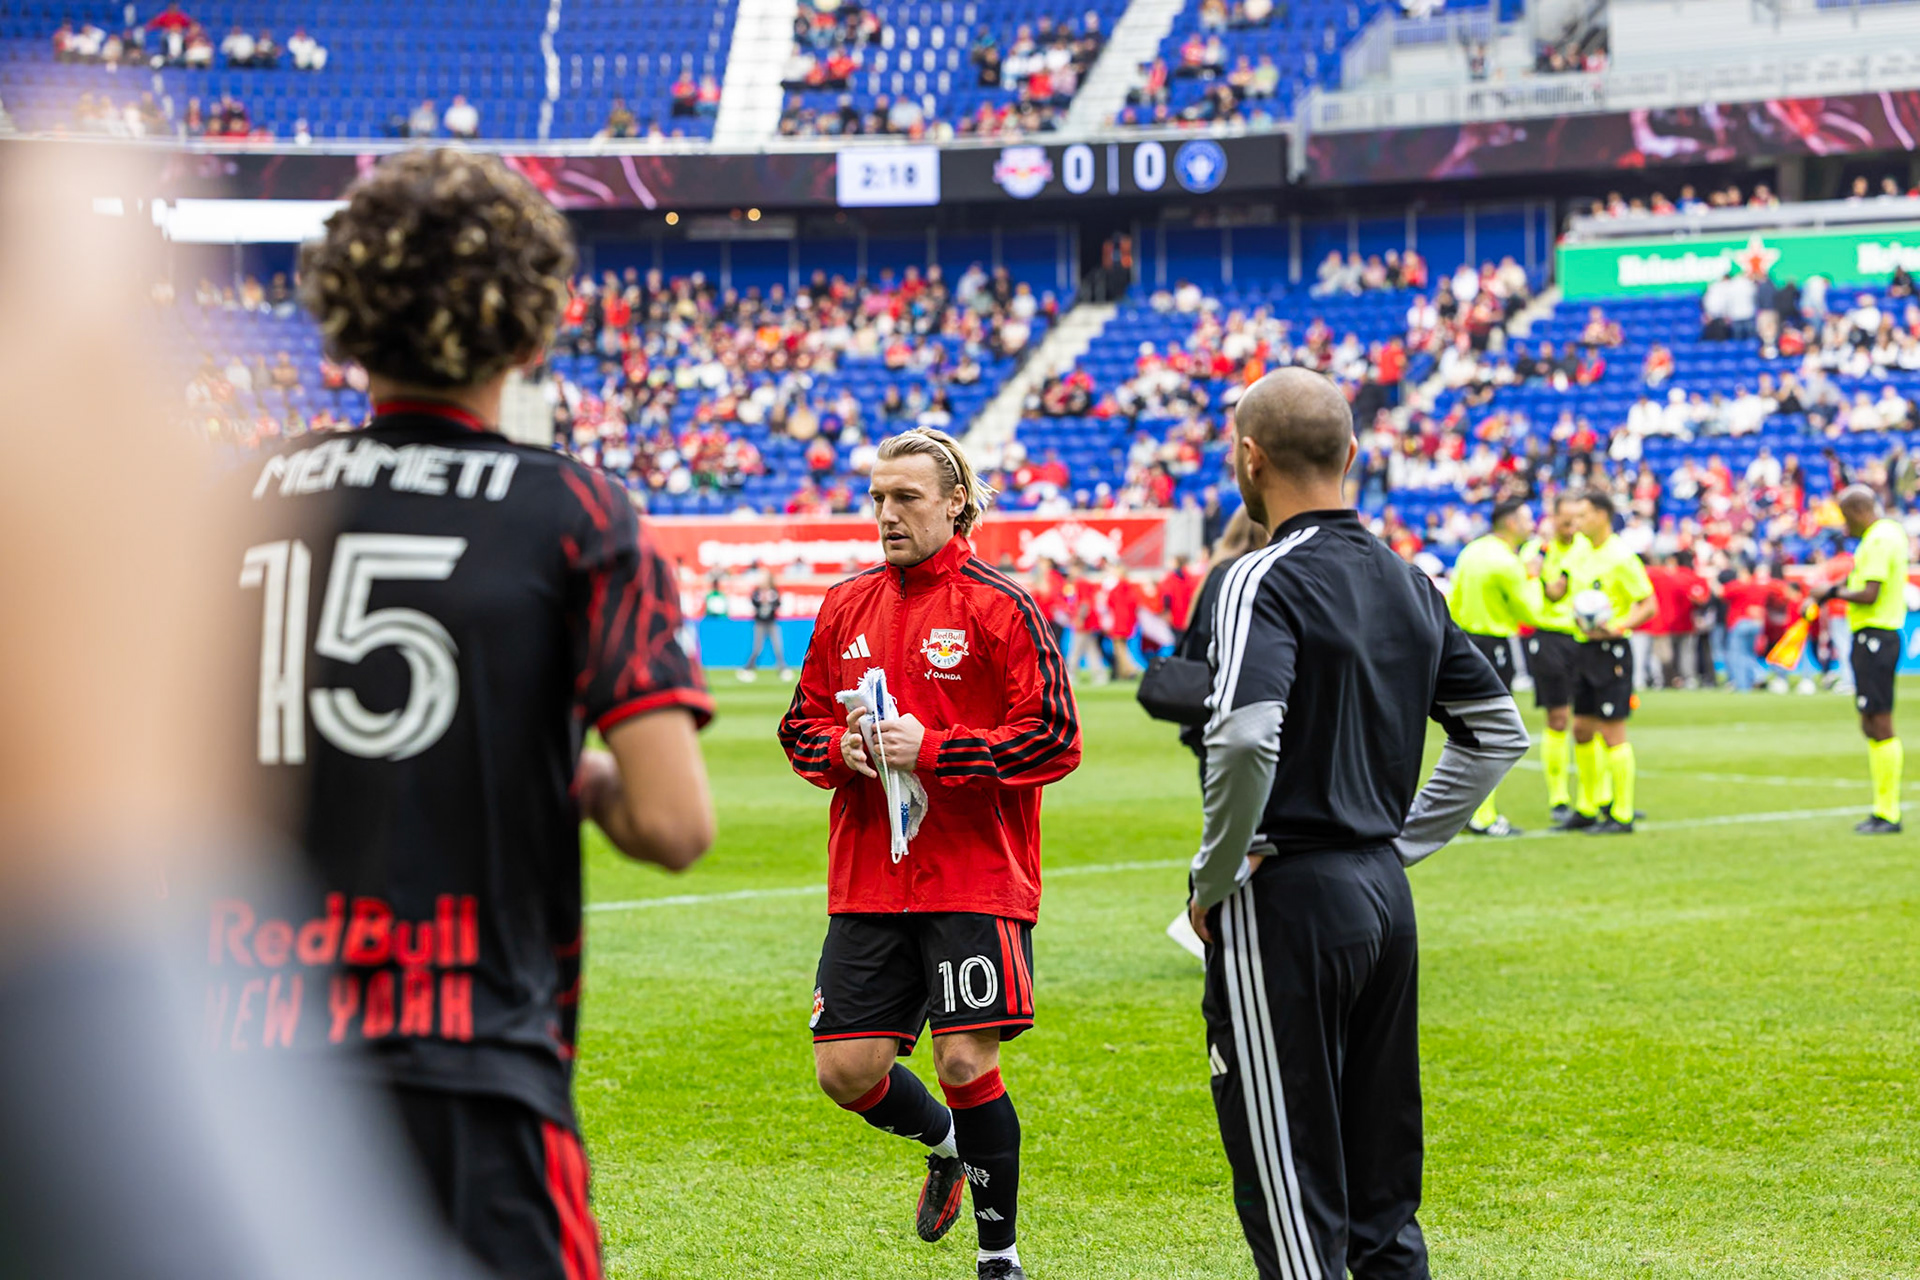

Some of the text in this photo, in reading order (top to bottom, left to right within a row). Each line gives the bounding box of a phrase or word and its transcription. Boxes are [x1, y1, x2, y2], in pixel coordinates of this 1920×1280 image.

[1063, 144, 1095, 194] 0
[1133, 141, 1166, 192] 0
[252, 438, 519, 501] MEHMETI
[239, 532, 468, 765] 15
[933, 671, 961, 680] OANDA
[938, 954, 999, 1013] 10
